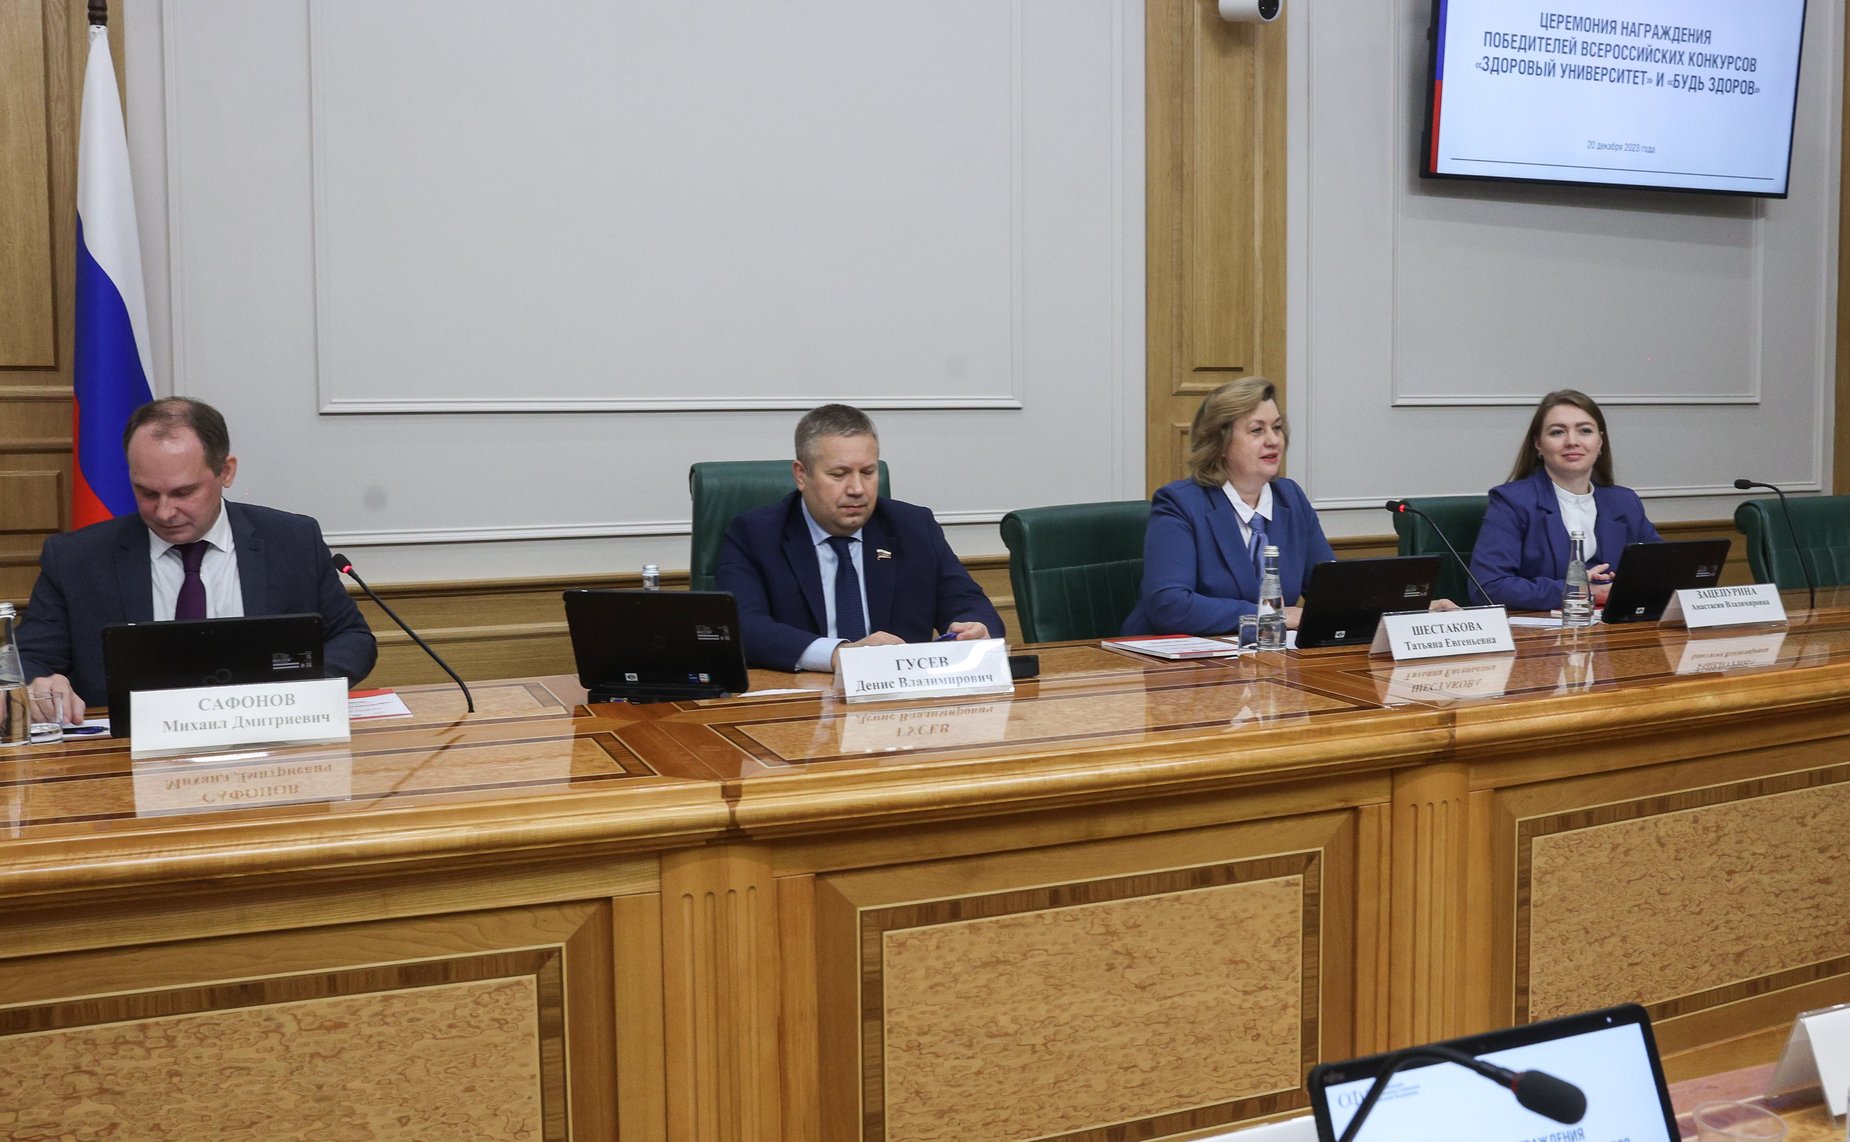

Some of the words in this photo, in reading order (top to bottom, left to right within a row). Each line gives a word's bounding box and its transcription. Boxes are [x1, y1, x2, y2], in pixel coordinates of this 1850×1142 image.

[1539, 12, 1617, 36] ЦЕРЕМОНИЯ
[1620, 20, 1712, 45] НАГРАЖДЕНИЯ
[1483, 31, 1577, 56] ПОБЕДИТЕЛЕЙ
[1580, 40, 1685, 66] ВСЕРОССИЙСКИХ
[1688, 51, 1757, 73] КОНКУРСОВ
[1475, 55, 1556, 78] «ЗДОРОВЫЙ
[1560, 62, 1653, 86] УНИВЕРСИТЕТ»
[1656, 72, 1665, 87] И
[1667, 73, 1705, 93] «БУДЬ
[1708, 76, 1760, 96] ЗДОРОВ»
[1697, 586, 1758, 600] ЗАЦЕПУРИНА
[1412, 621, 1483, 636] ШЕСТАКОВА
[1404, 641, 1444, 651] Татьяна
[1446, 636, 1497, 650] Евгеньевна
[895, 656, 950, 671] ГУСЕВ
[856, 680, 896, 693] Денис
[898, 673, 995, 689] Владимирович
[198, 693, 297, 712] САФОНОВ
[162, 718, 228, 734] Михаил
[231, 712, 331, 731] Дмитриевич
